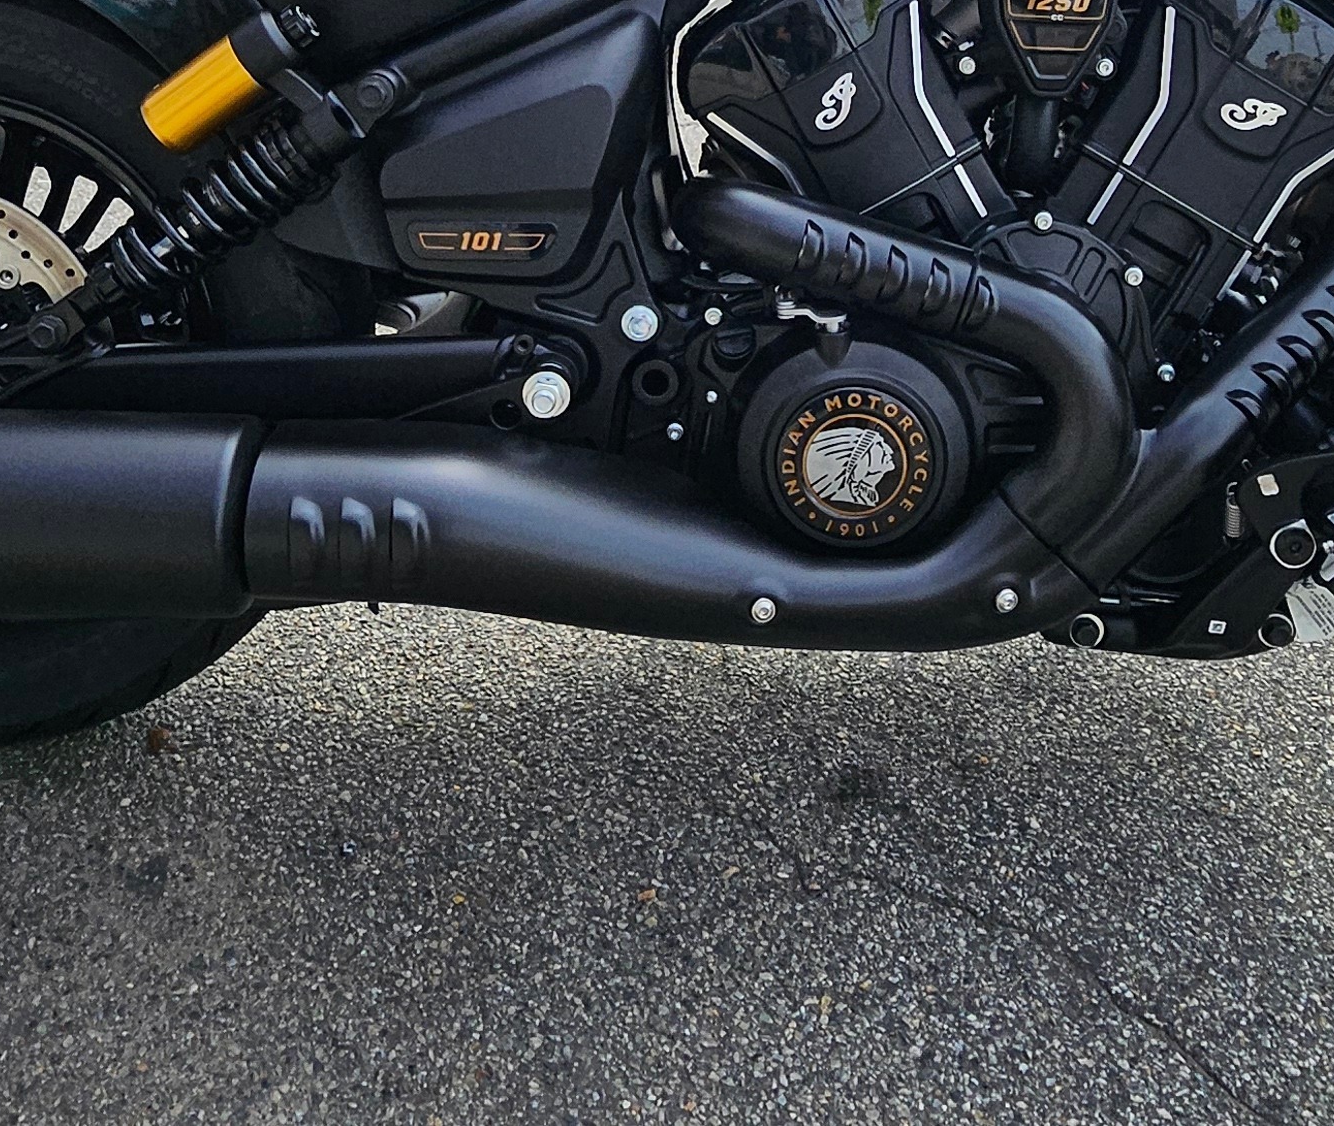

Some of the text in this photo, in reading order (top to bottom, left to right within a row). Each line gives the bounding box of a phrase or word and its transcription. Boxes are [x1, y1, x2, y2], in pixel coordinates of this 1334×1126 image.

[460, 231, 503, 251] 101
[781, 392, 930, 512] INDIAN MOTORCYCLE
[825, 520, 879, 537] 1901
